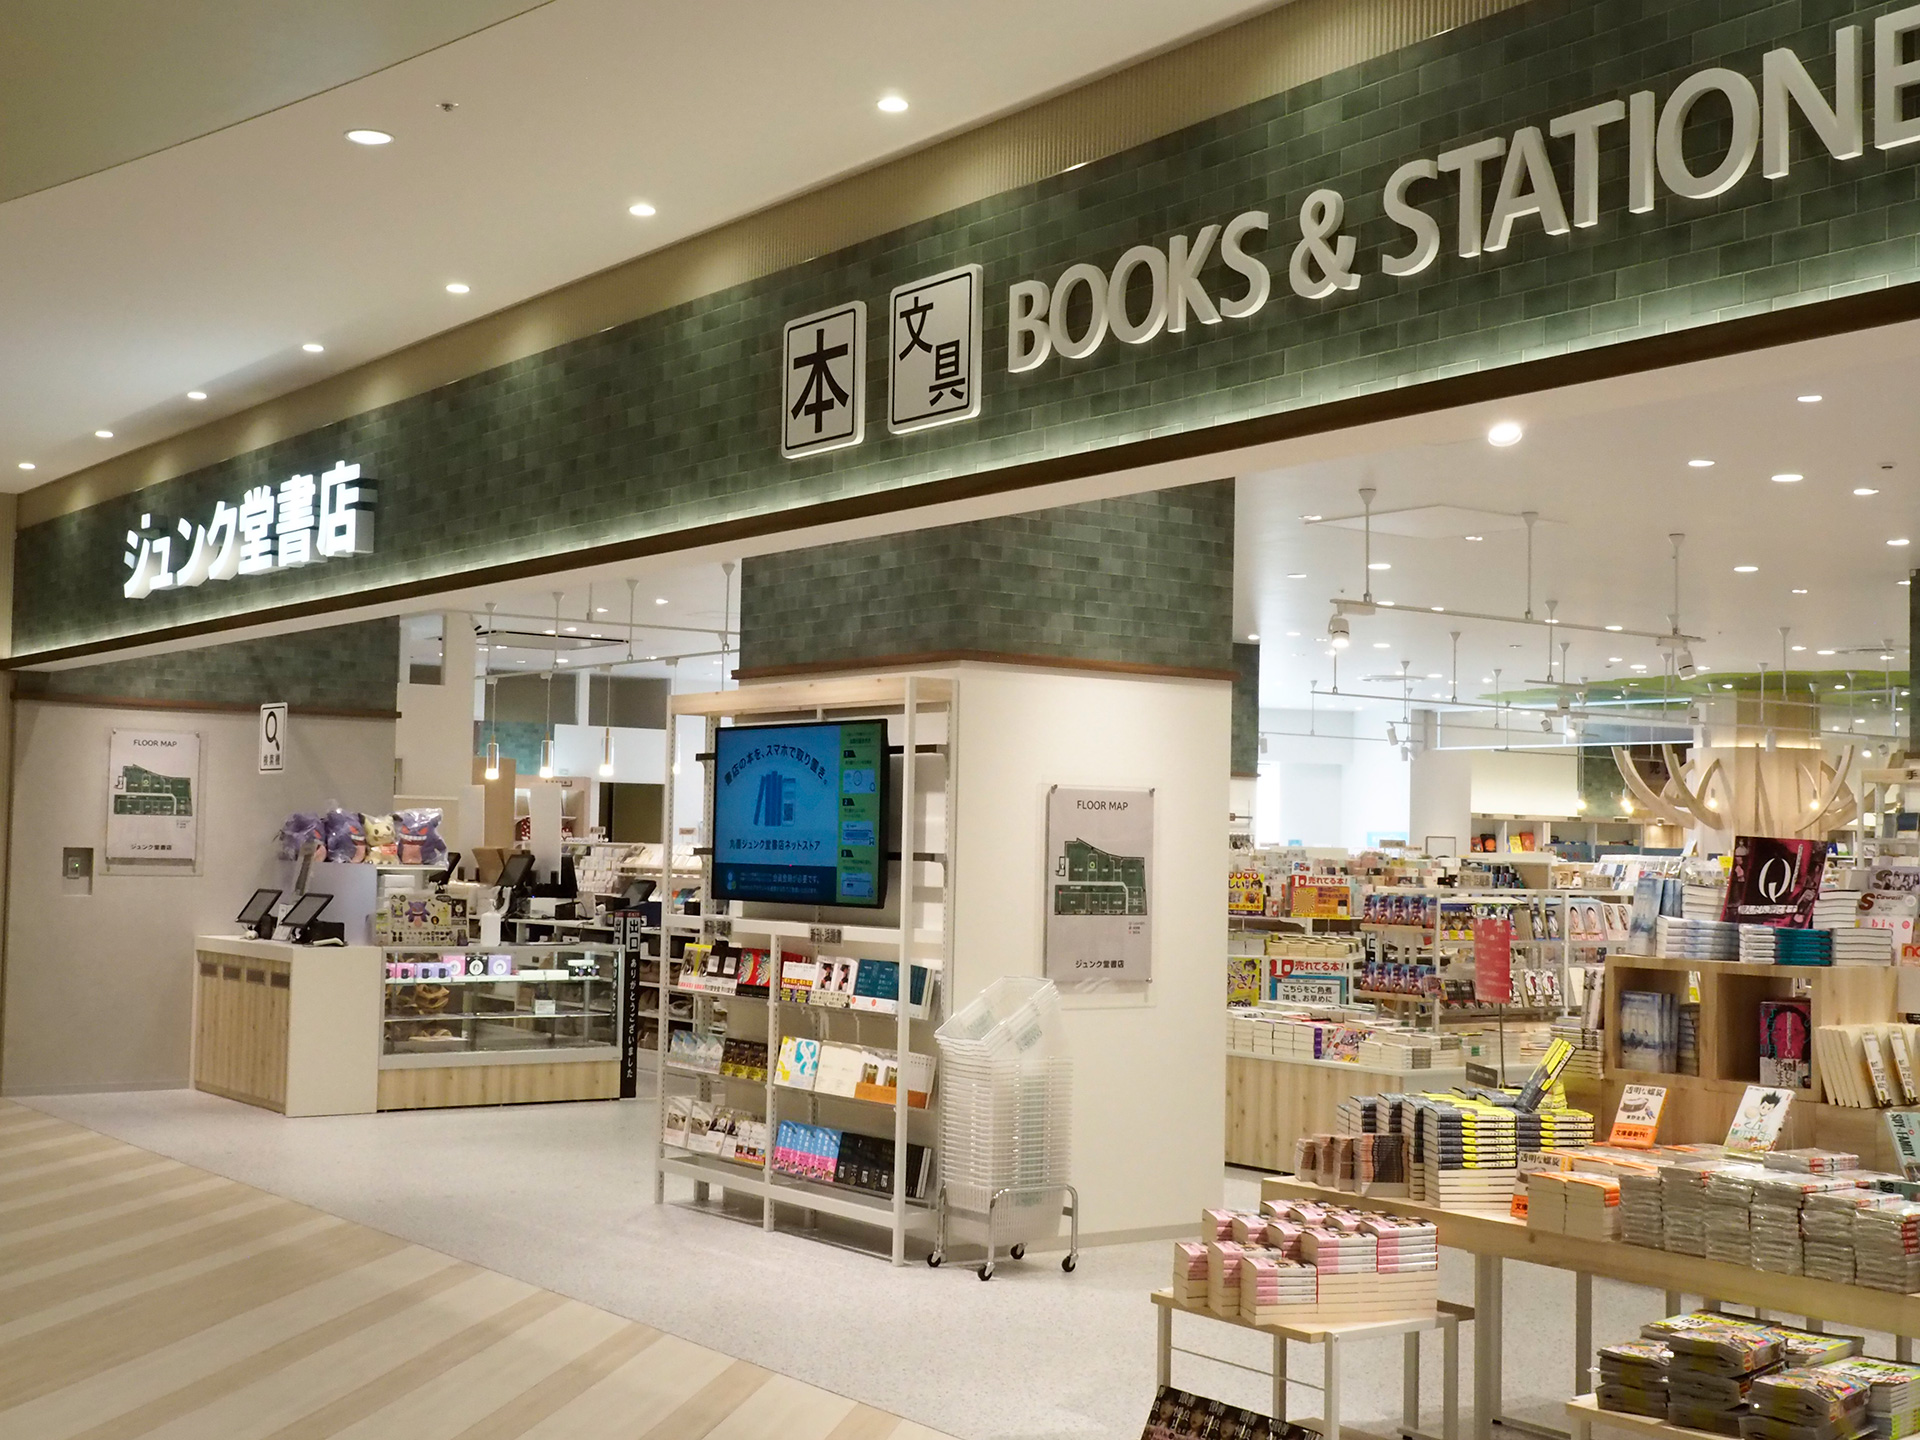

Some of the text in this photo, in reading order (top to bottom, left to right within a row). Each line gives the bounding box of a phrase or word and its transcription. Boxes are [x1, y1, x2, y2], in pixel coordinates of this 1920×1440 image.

[1007, 209, 1270, 374] BOOKS
[1288, 188, 1361, 300] &
[790, 328, 850, 434] 本
[898, 296, 966, 407] 文具
[124, 459, 368, 599] ジュンク堂書店
[133, 738, 178, 748] FLOOR MAP
[130, 843, 173, 851] ジュンク堂書店
[1076, 800, 1129, 811] FLOOR MAP
[1075, 959, 1125, 969] ジュンク堂書店
[626, 958, 638, 1079] ありがとうございました
